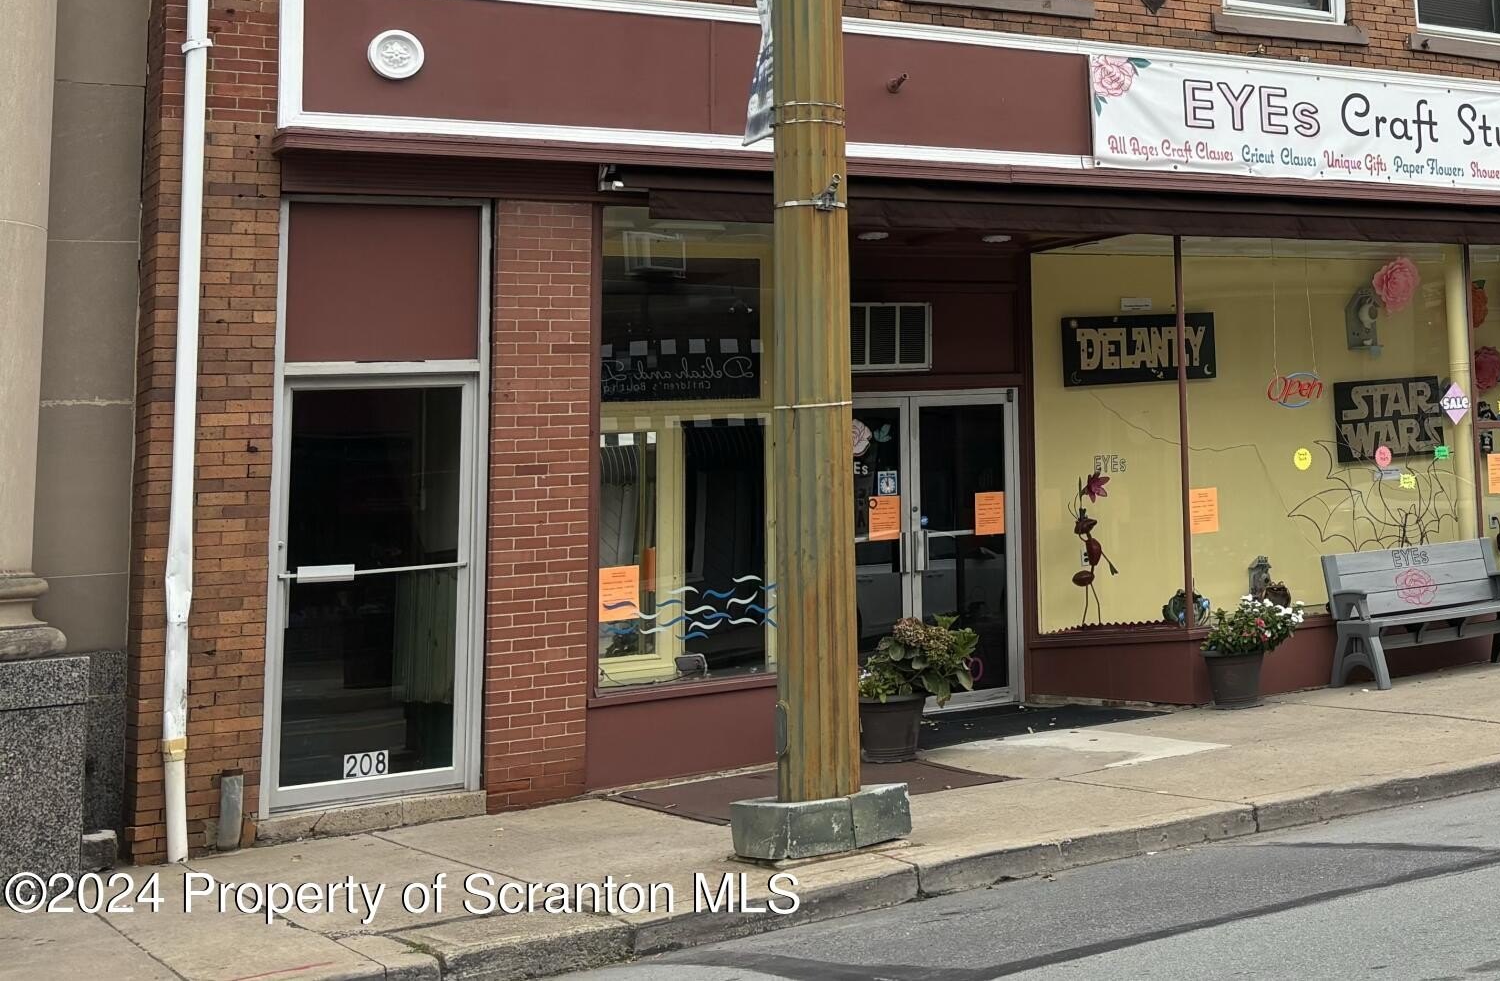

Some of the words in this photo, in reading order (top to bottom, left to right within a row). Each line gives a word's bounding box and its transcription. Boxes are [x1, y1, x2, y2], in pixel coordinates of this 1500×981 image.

[1183, 79, 1320, 137] EYEs
[1341, 92, 1438, 154] Craft
[1108, 135, 1127, 155] All
[1130, 137, 1158, 161] Ages
[1161, 139, 1193, 164] Craft
[1196, 141, 1234, 162] Classes
[1241, 144, 1275, 165] Cricut
[1281, 147, 1317, 167] Classes
[1323, 150, 1362, 175] Unique
[1364, 153, 1388, 176] Gifts
[1393, 156, 1425, 178] Paper
[1426, 158, 1465, 177] Flowers
[1267, 377, 1323, 404] Open
[1342, 382, 1439, 420] STAR
[1341, 416, 1443, 458] WARS
[1094, 454, 1127, 474] EYEs
[345, 751, 386, 778] 208
